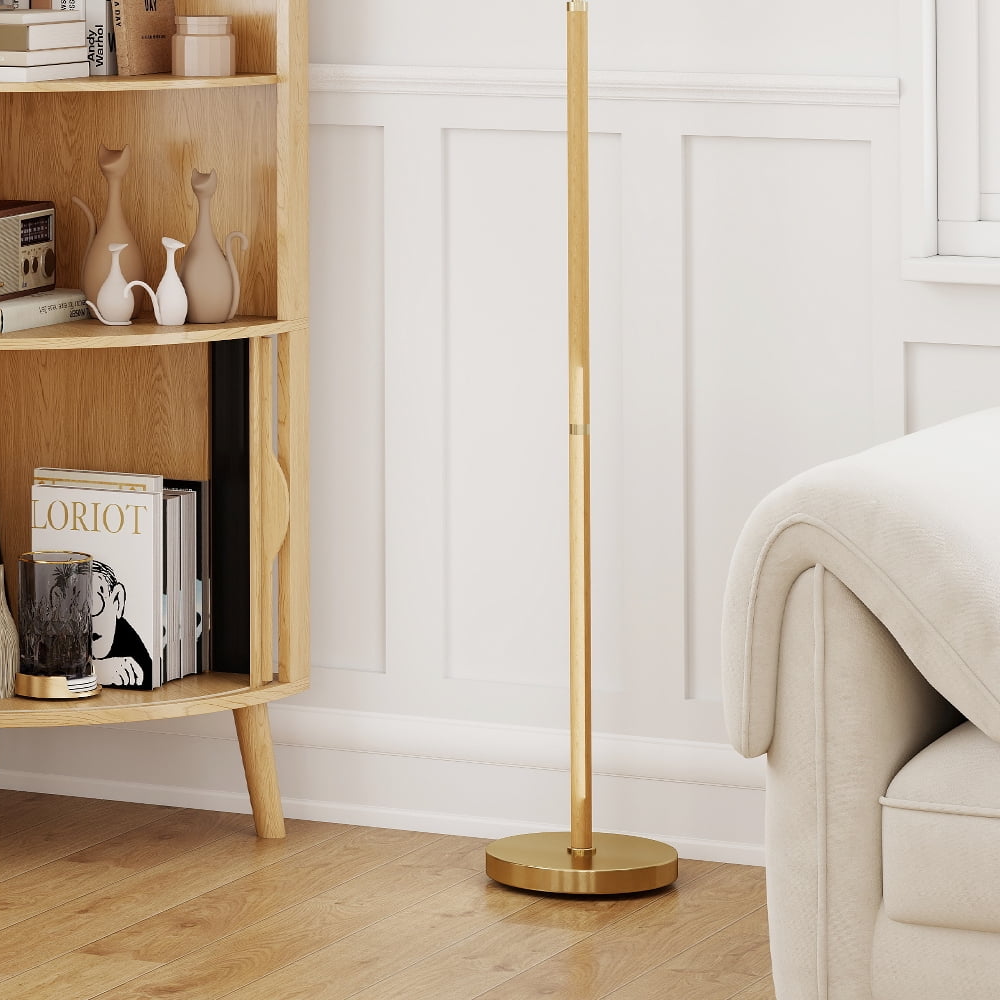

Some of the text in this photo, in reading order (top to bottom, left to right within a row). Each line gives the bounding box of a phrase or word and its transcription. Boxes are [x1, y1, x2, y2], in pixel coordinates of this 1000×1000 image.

[114, 9, 122, 27] DAY
[87, 29, 98, 62] Andy
[95, 24, 104, 68] Warhol
[31, 499, 148, 535] LORIOT
